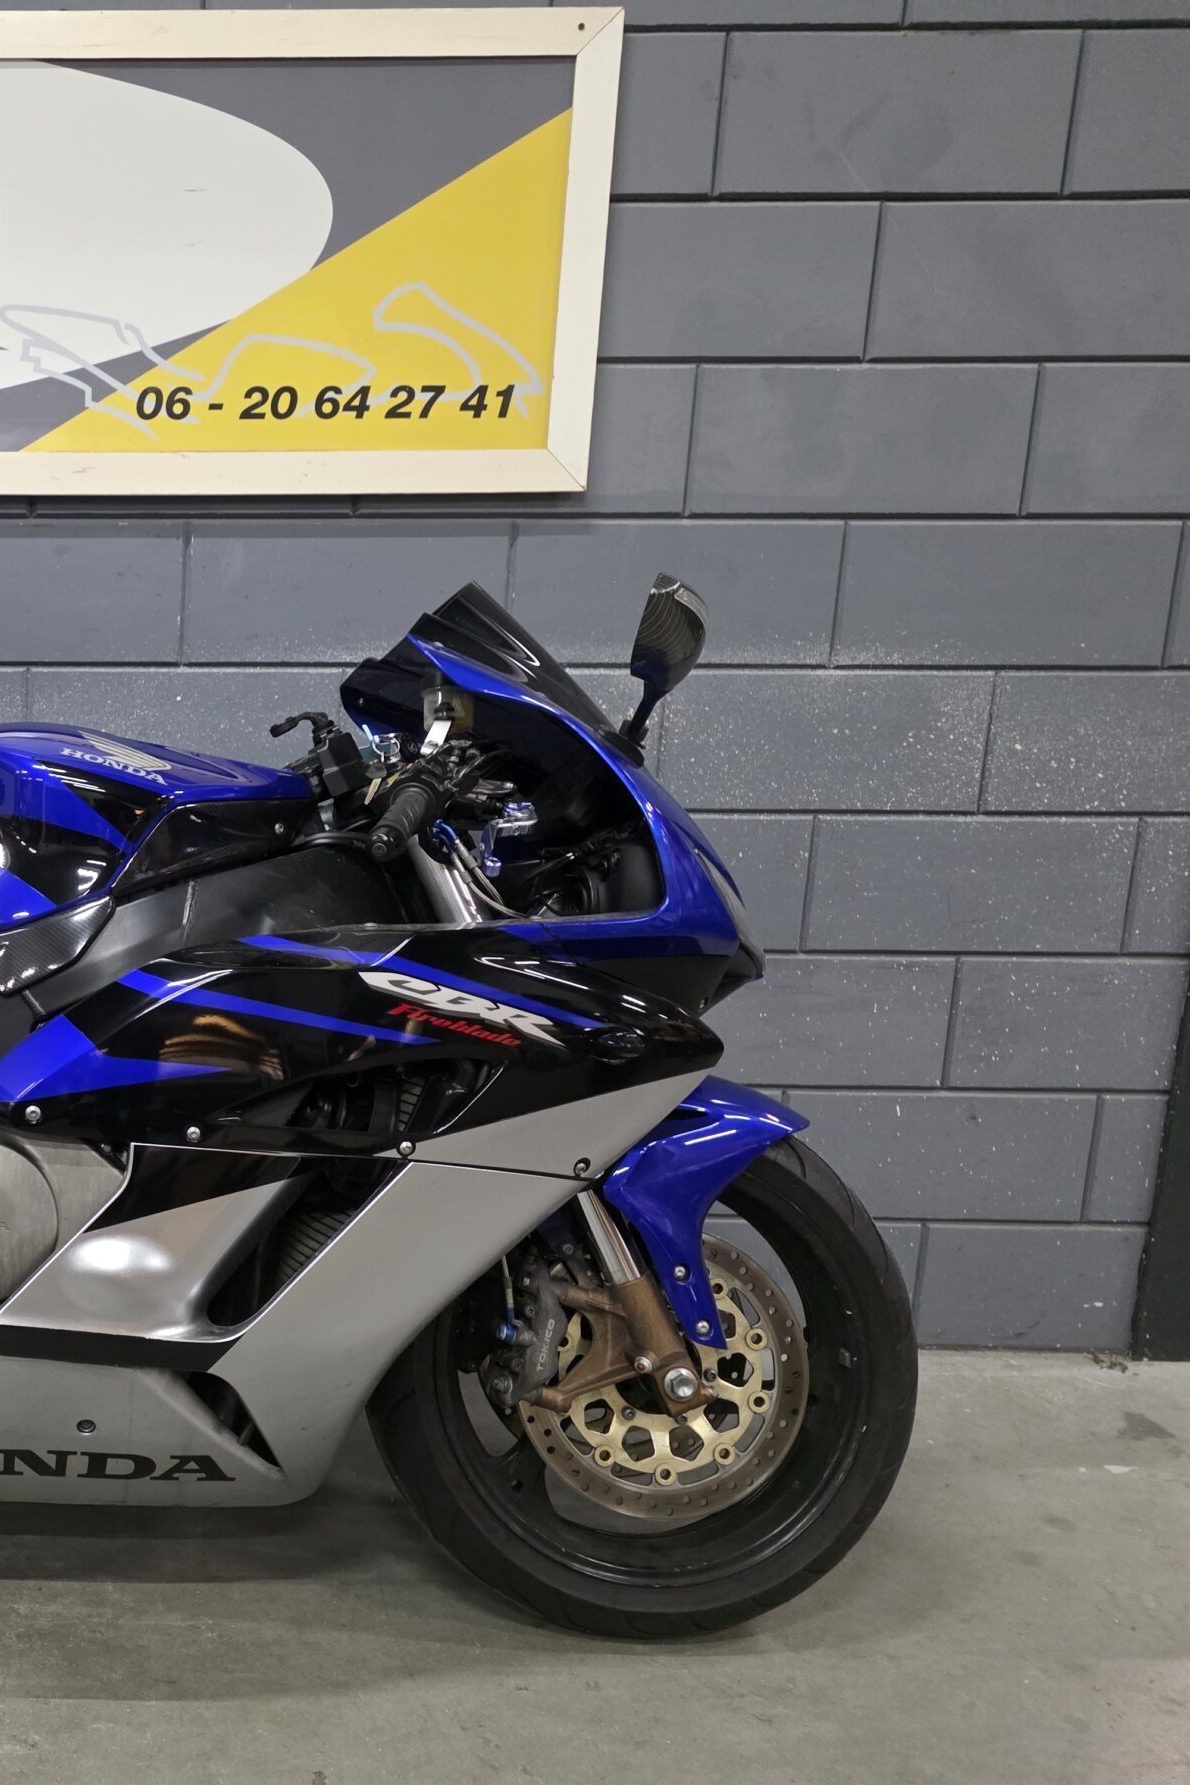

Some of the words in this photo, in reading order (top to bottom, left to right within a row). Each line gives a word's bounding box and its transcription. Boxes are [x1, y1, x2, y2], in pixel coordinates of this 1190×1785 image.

[136, 386, 192, 420] 06
[239, 386, 298, 420] 20
[314, 385, 371, 419] 64
[385, 385, 446, 419] 27
[460, 384, 515, 419] 41
[60, 747, 168, 786] HONDA
[358, 972, 567, 1048] CBR
[387, 1003, 521, 1046] Fireblade
[536, 1318, 556, 1372] TOKICO
